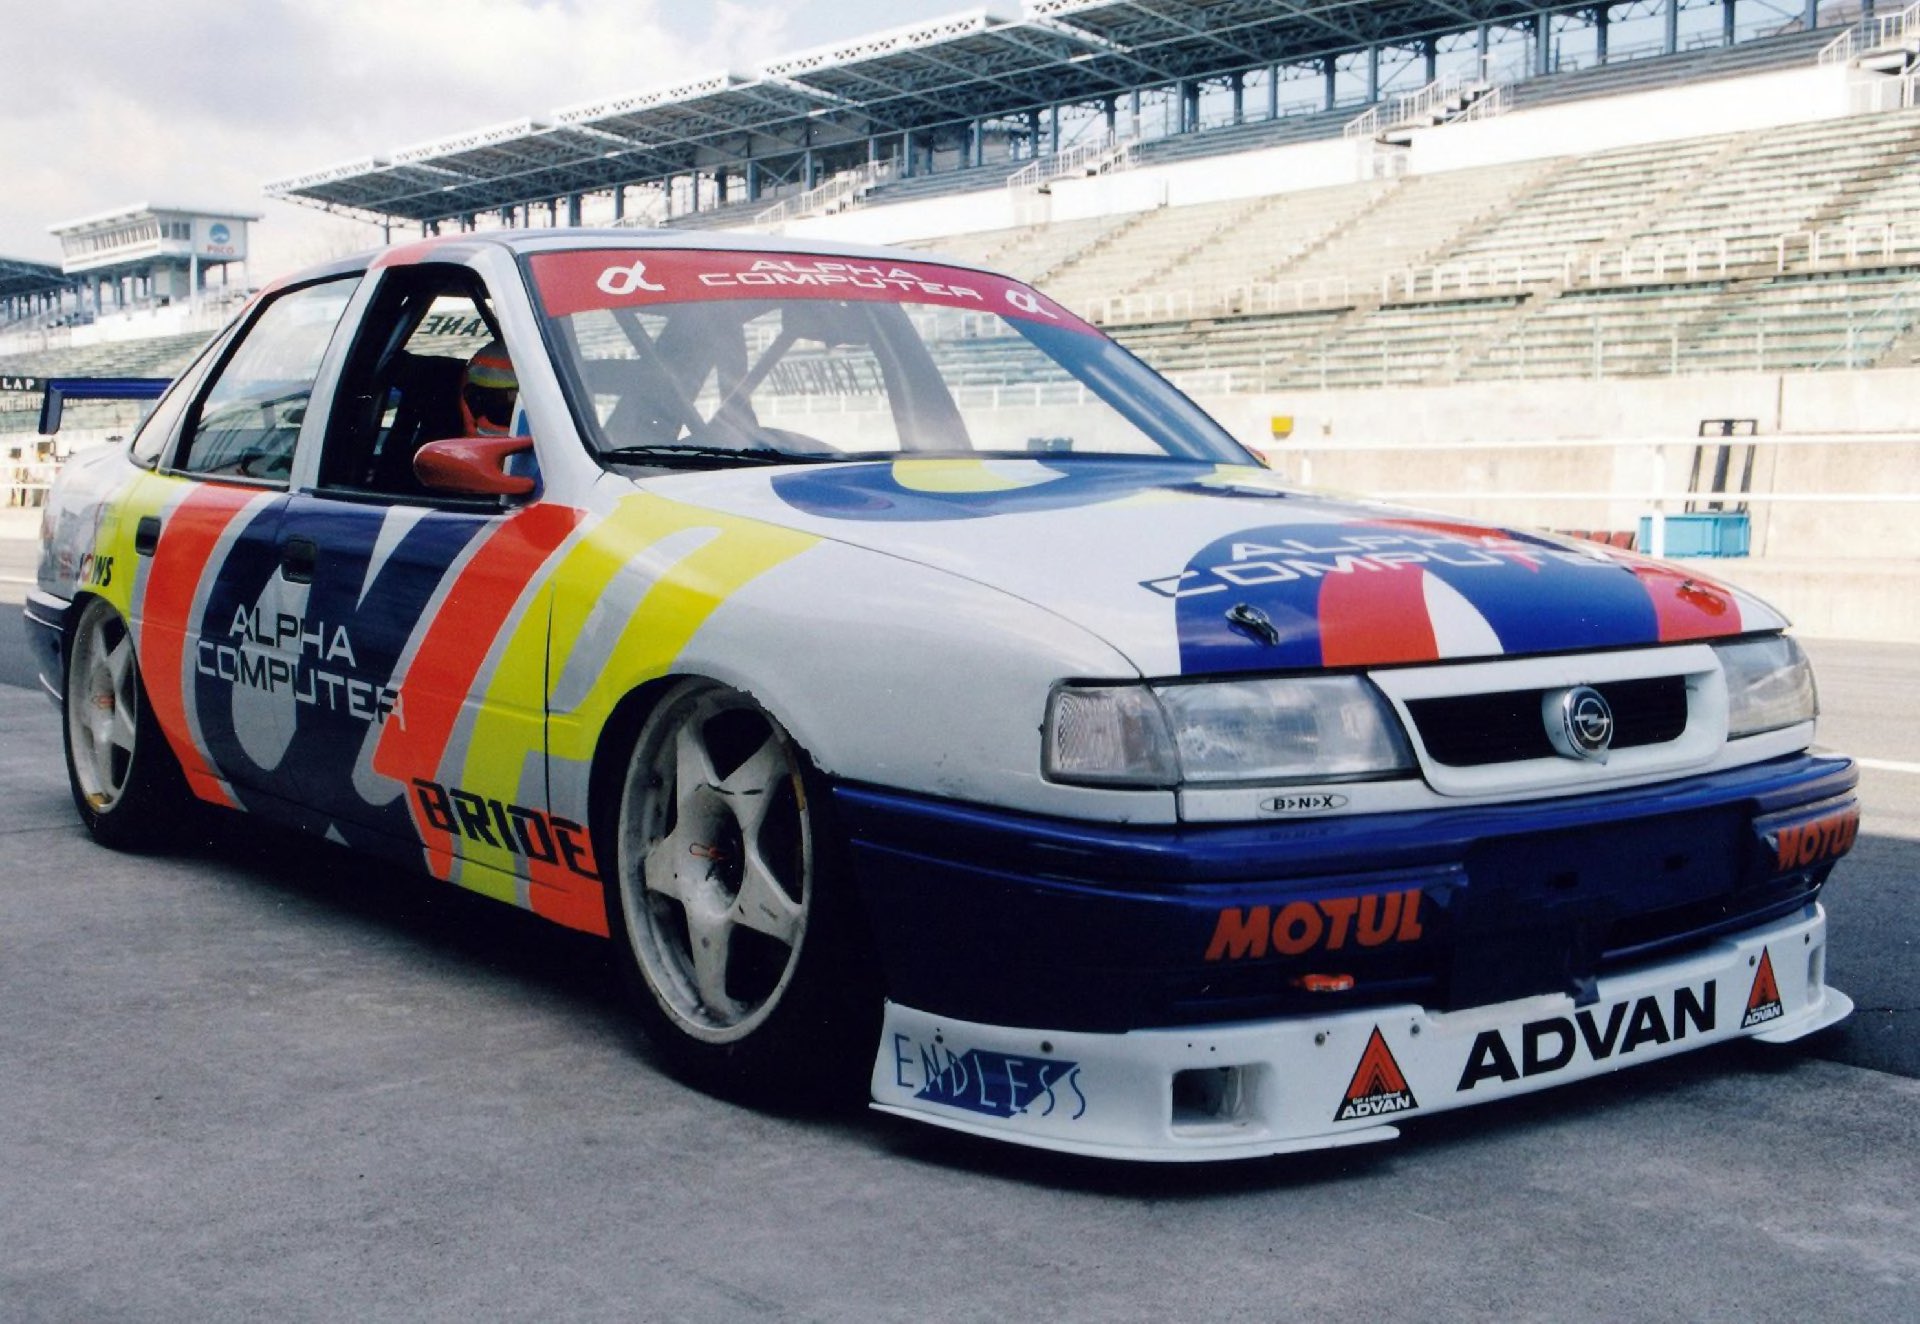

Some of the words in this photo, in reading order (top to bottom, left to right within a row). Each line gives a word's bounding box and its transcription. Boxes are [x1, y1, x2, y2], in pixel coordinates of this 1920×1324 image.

[699, 273, 984, 300] COMPUTER
[751, 260, 924, 281] ALPHA
[2, 377, 35, 390] LAP
[1232, 534, 1522, 561] ALPHA
[228, 603, 356, 668] ALPHA
[197, 640, 406, 732] COMPUTER
[413, 777, 602, 881] BRIDE
[1205, 888, 1422, 961] MOTUL
[1456, 979, 1716, 1092] ADVAN
[1744, 1005, 1781, 1026] ADVAN
[894, 1033, 1086, 1120] ENDLESS
[1342, 1095, 1410, 1119] ADVAN
